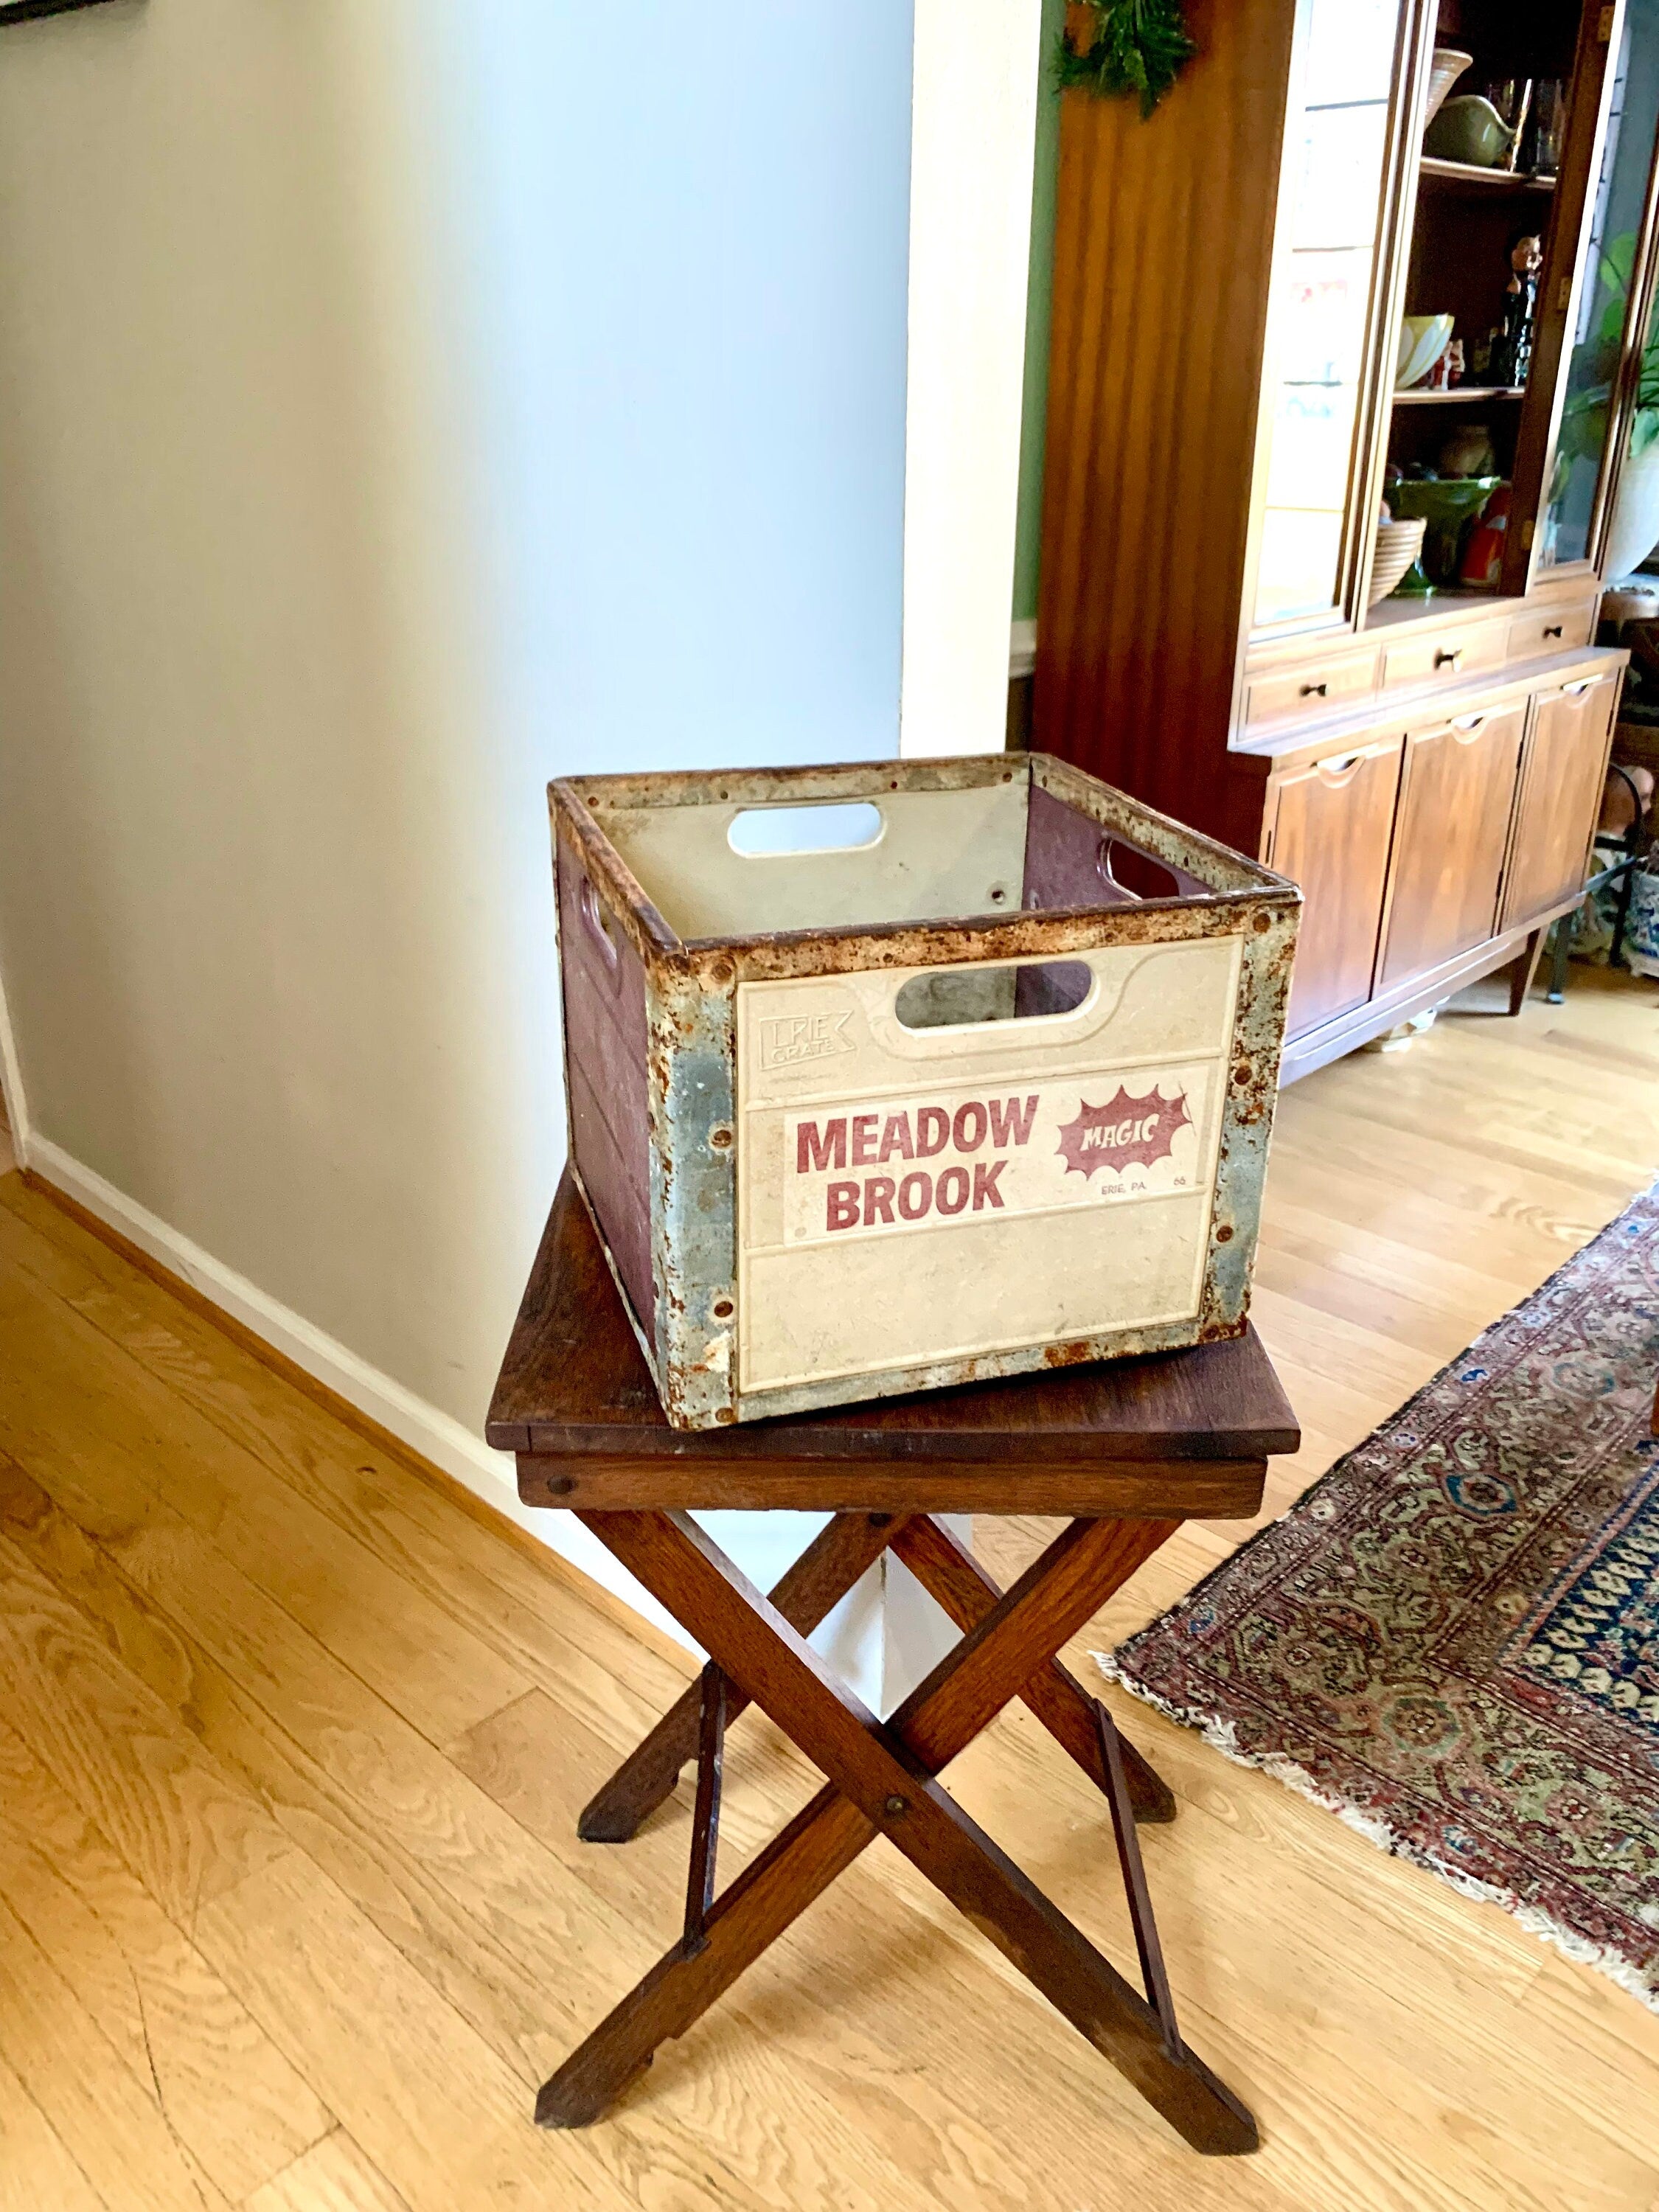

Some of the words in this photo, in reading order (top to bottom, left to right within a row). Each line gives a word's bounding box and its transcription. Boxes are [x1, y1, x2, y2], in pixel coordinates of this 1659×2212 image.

[771, 1039, 836, 1063] CRATE
[796, 1094, 1040, 1174] MEADOW
[1079, 1113, 1160, 1151] MAGIC
[826, 1159, 1009, 1232] BROOK
